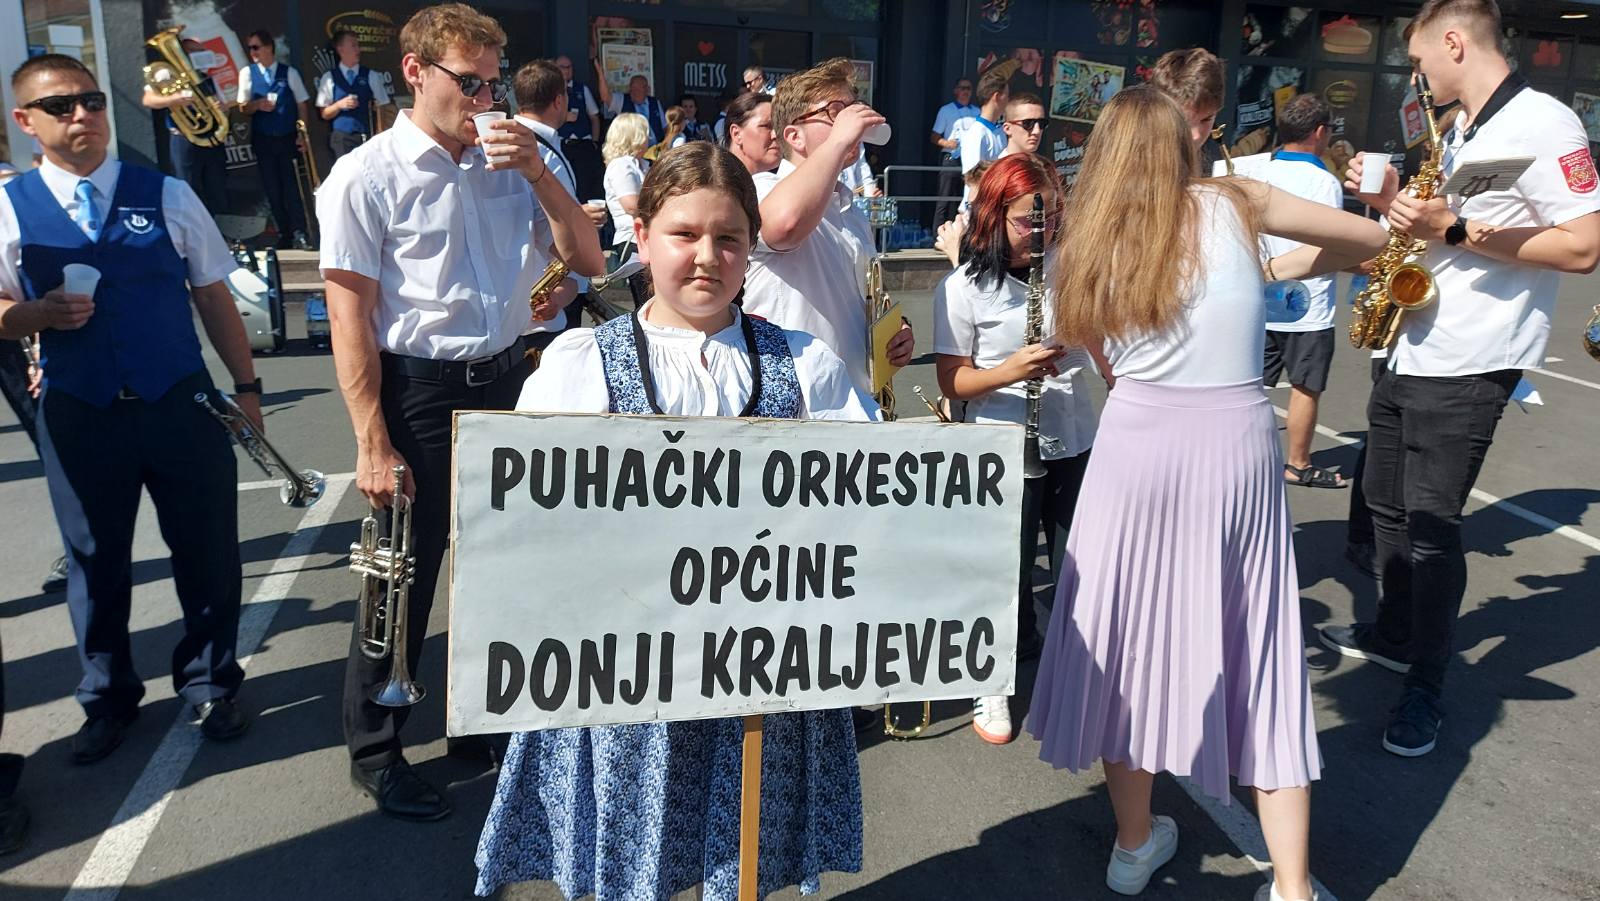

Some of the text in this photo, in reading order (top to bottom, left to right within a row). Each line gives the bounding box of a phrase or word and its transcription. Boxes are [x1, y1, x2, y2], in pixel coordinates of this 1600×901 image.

[684, 62, 727, 88] METSS
[492, 430, 1005, 511] PUHAČKI ORKESTAR
[670, 529, 858, 605] OPĆINE
[486, 616, 996, 715] DONJI KRALJEVEC
